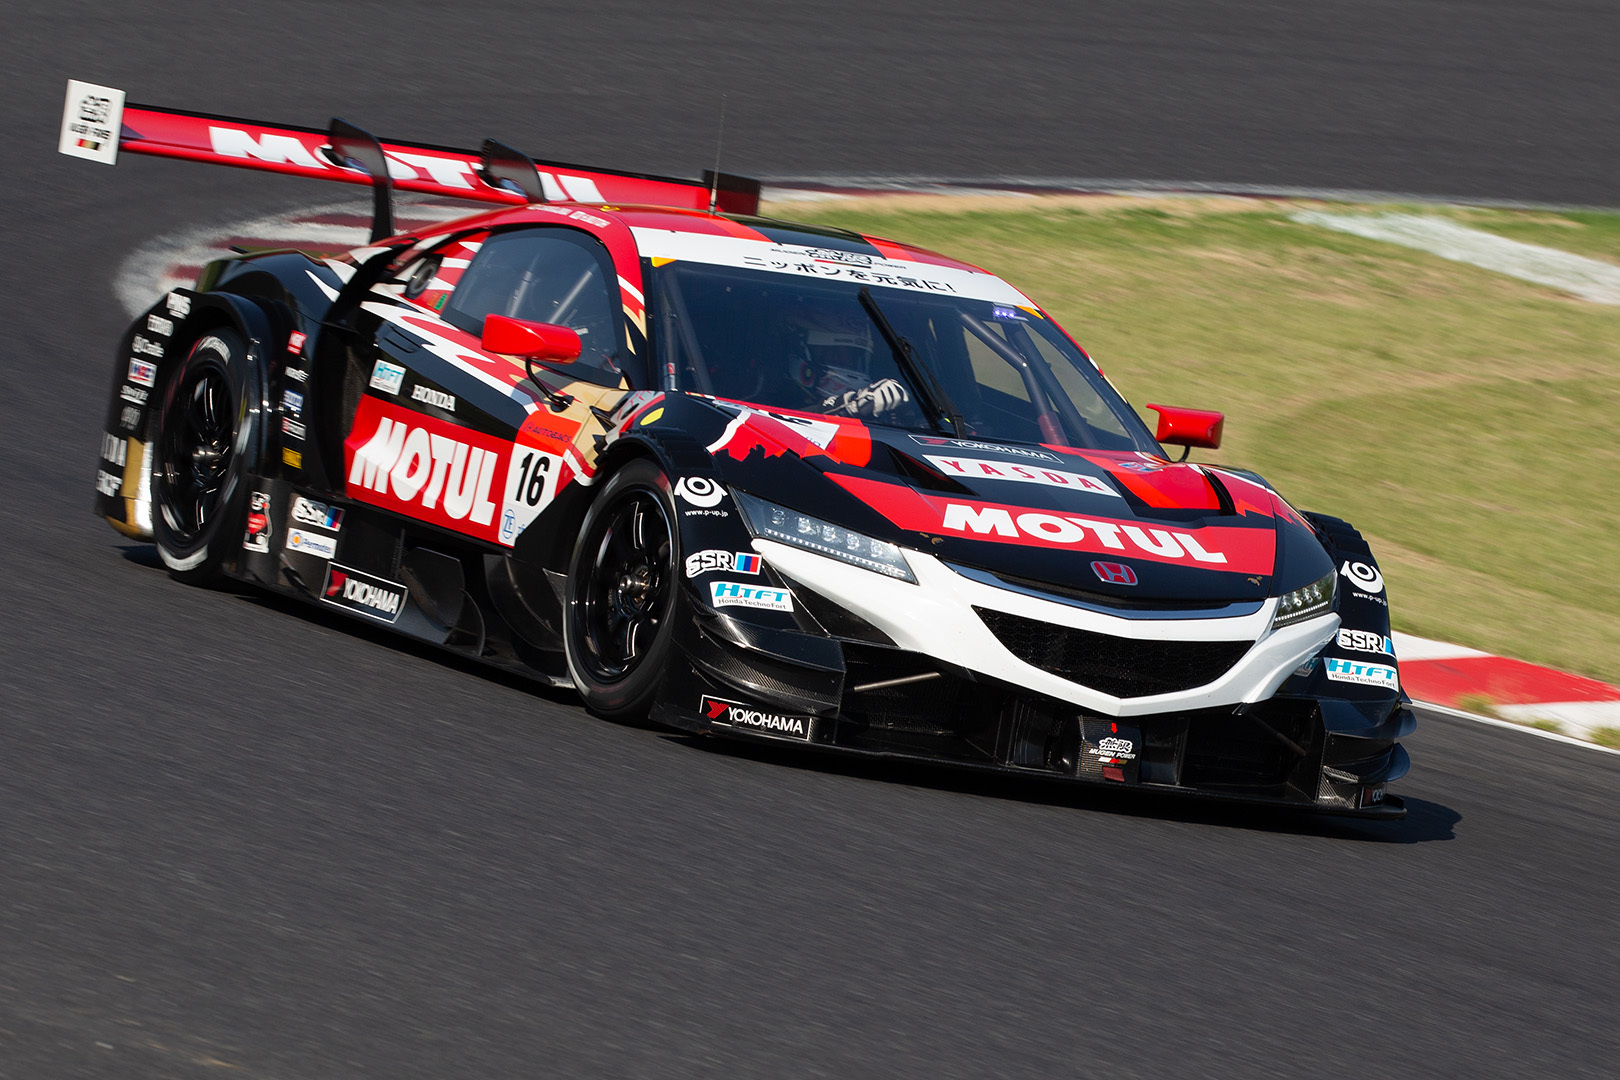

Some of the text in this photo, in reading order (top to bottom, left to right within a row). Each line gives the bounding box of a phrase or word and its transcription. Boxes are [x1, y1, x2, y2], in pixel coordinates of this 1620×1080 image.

[411, 384, 456, 412] HONDA
[532, 427, 572, 443] AUTOBACS
[951, 440, 1054, 461] YOKOHAMA
[348, 416, 498, 526] MOTUL
[515, 452, 550, 507] 16
[941, 459, 1105, 491] YASDA
[685, 509, 729, 517] www.p-up.jp
[942, 503, 1228, 564] MOTUL
[686, 550, 734, 578] SSR
[343, 577, 400, 614] YOKOHAMA
[1336, 628, 1383, 653] SSR
[728, 706, 804, 734] YOKOHAMA
